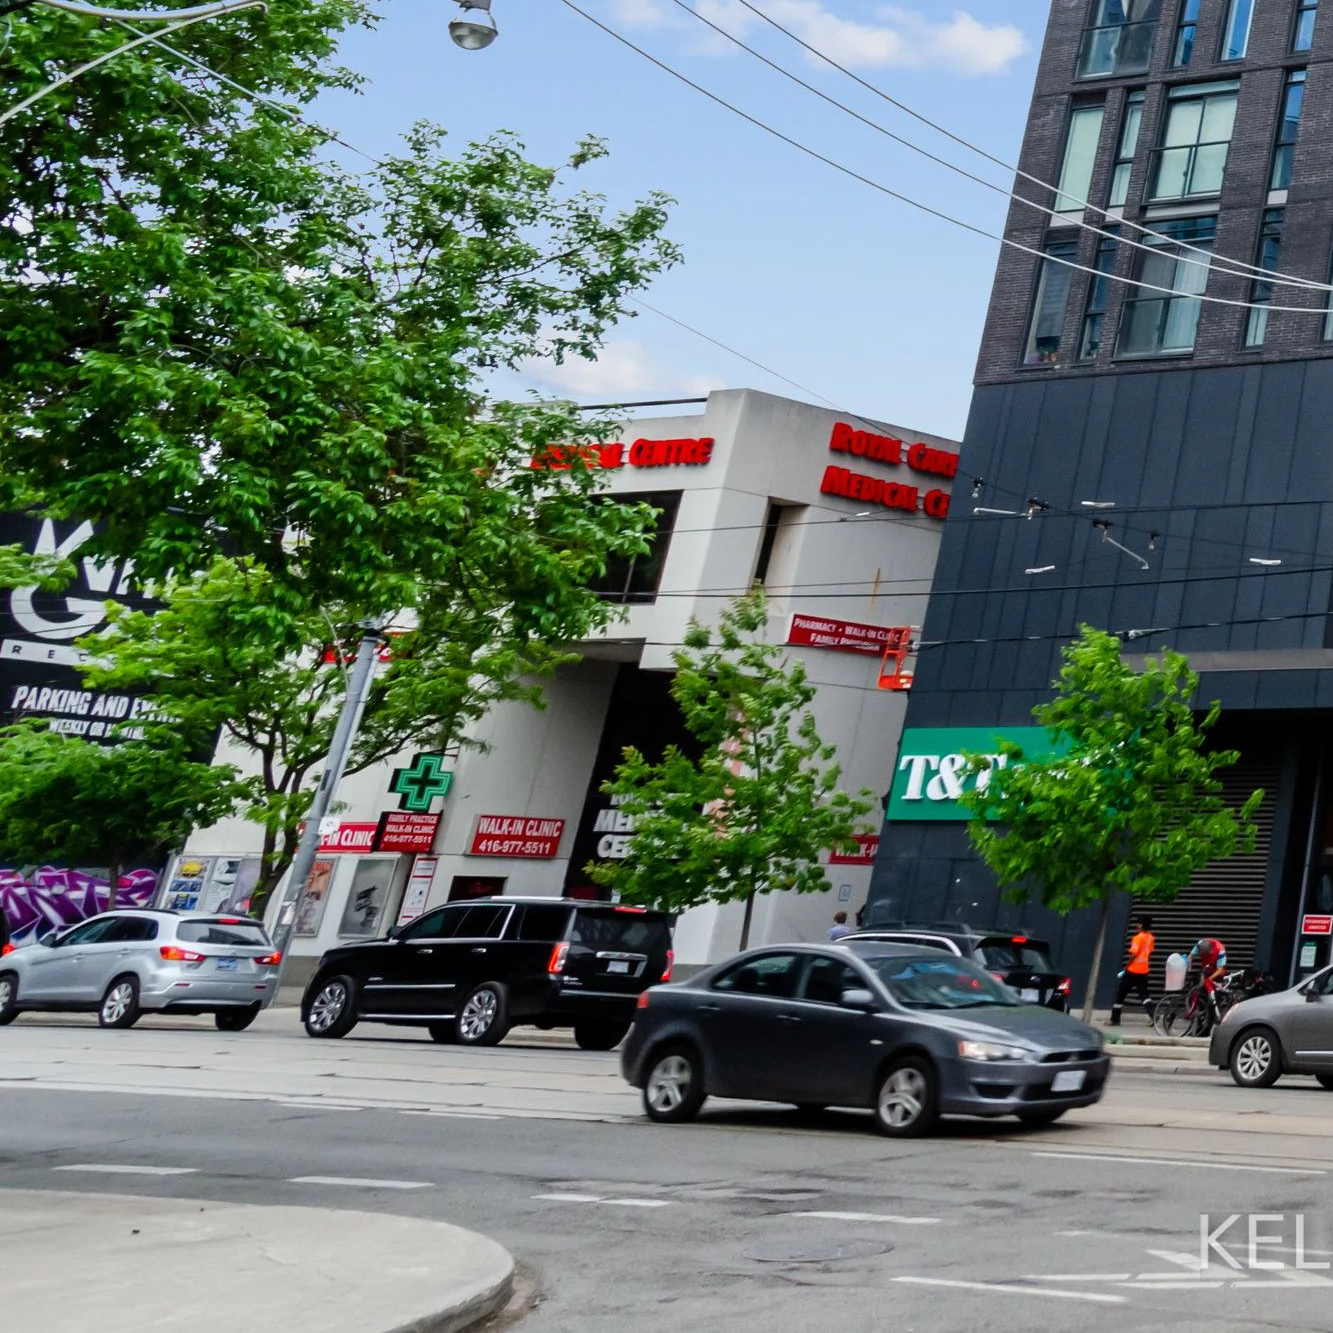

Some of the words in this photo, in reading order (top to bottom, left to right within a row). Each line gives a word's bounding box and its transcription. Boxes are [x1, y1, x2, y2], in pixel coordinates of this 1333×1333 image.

[629, 437, 715, 468] CENTRE
[830, 422, 902, 465] ROYAL
[820, 465, 919, 512] MEDICAL
[11, 686, 92, 715] PARKING
[91, 694, 130, 718] AND
[49, 719, 89, 735] WEEKLY
[89, 721, 106, 737] OR
[341, 829, 375, 846] CLINIC
[478, 817, 523, 836] WALK-IN
[525, 819, 562, 837] CLINIC
[478, 839, 551, 854] 416-977-5511
